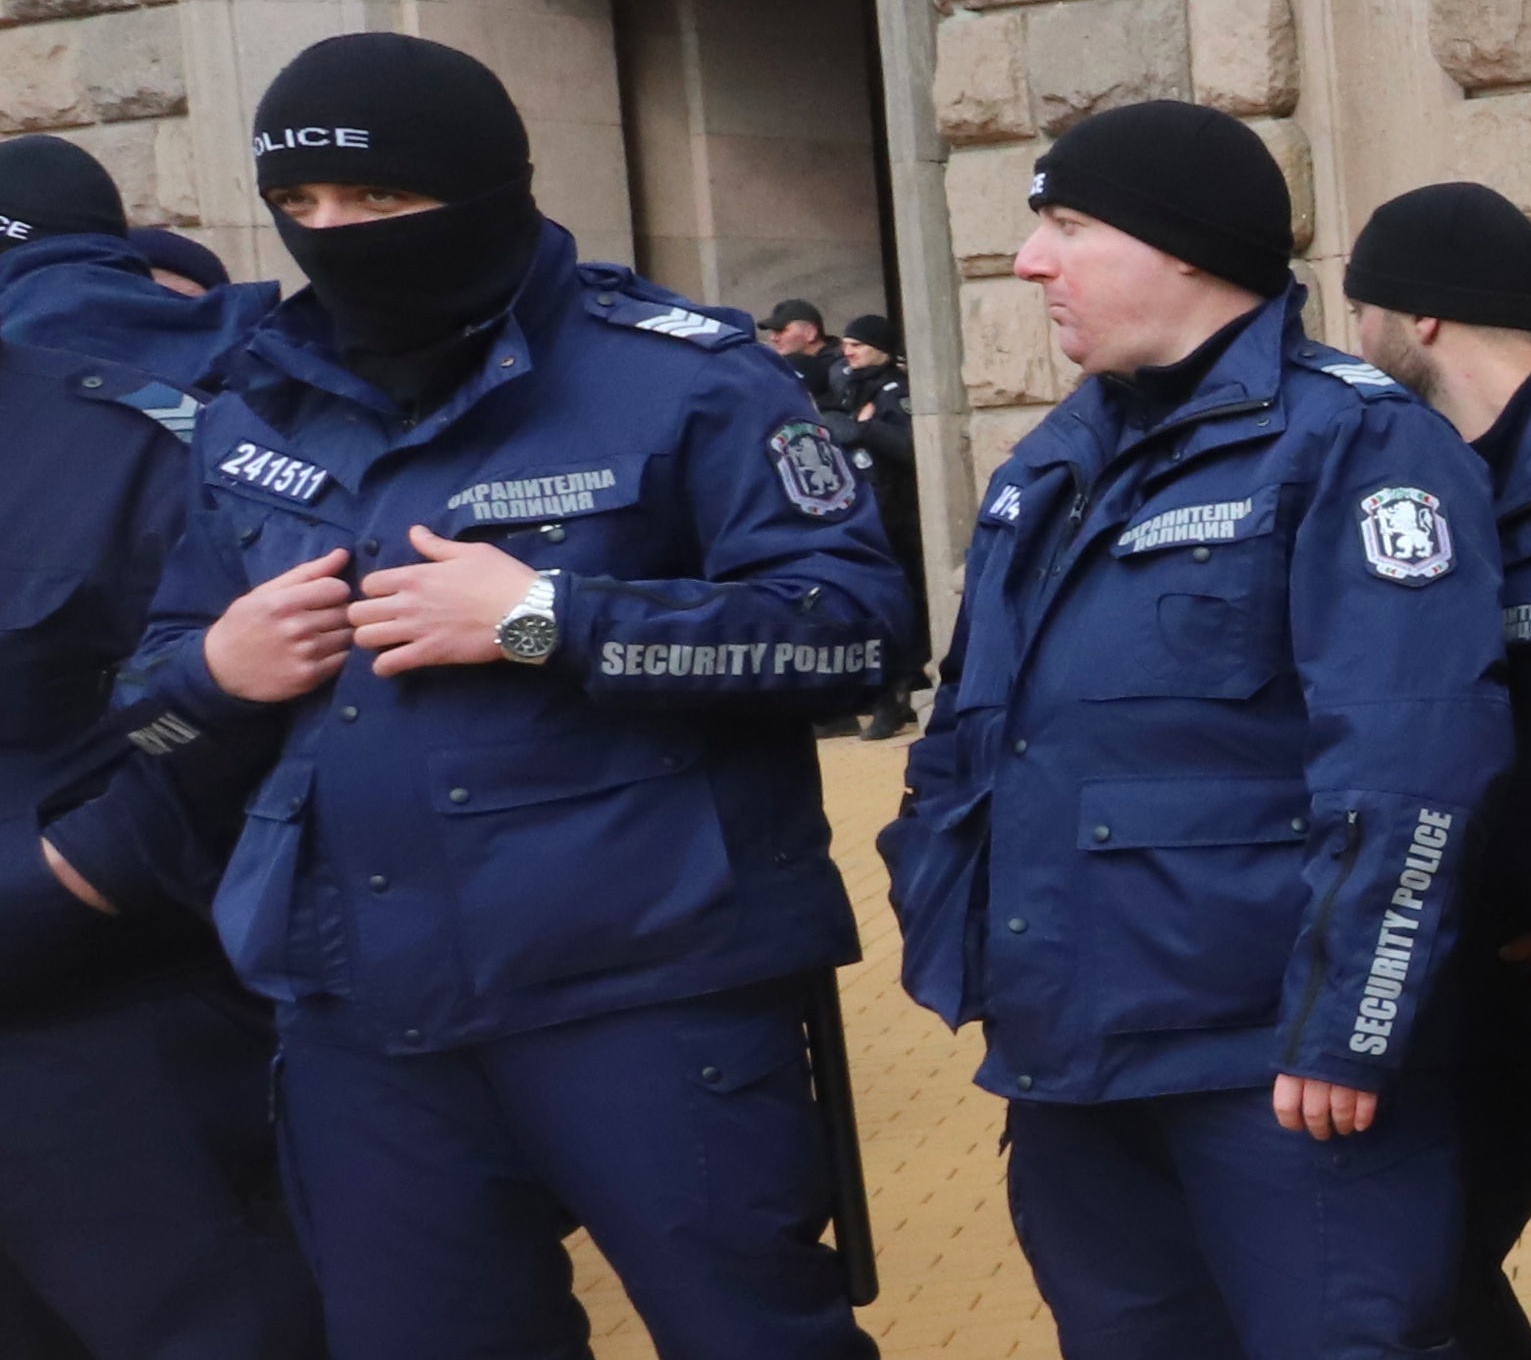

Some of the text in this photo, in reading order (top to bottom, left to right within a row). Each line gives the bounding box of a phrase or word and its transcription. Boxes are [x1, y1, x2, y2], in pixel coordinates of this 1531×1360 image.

[252, 127, 370, 157] OLICE
[220, 443, 327, 500] 241511
[447, 468, 616, 510] ОХРАНИТЕЛНА
[473, 491, 594, 520] ПОЛИЦИЯ
[1132, 520, 1235, 552] ПОЛИЦИЯ
[601, 639, 881, 676] SECURITY POLICE
[1349, 808, 1452, 1056] SECURITY POLICE
